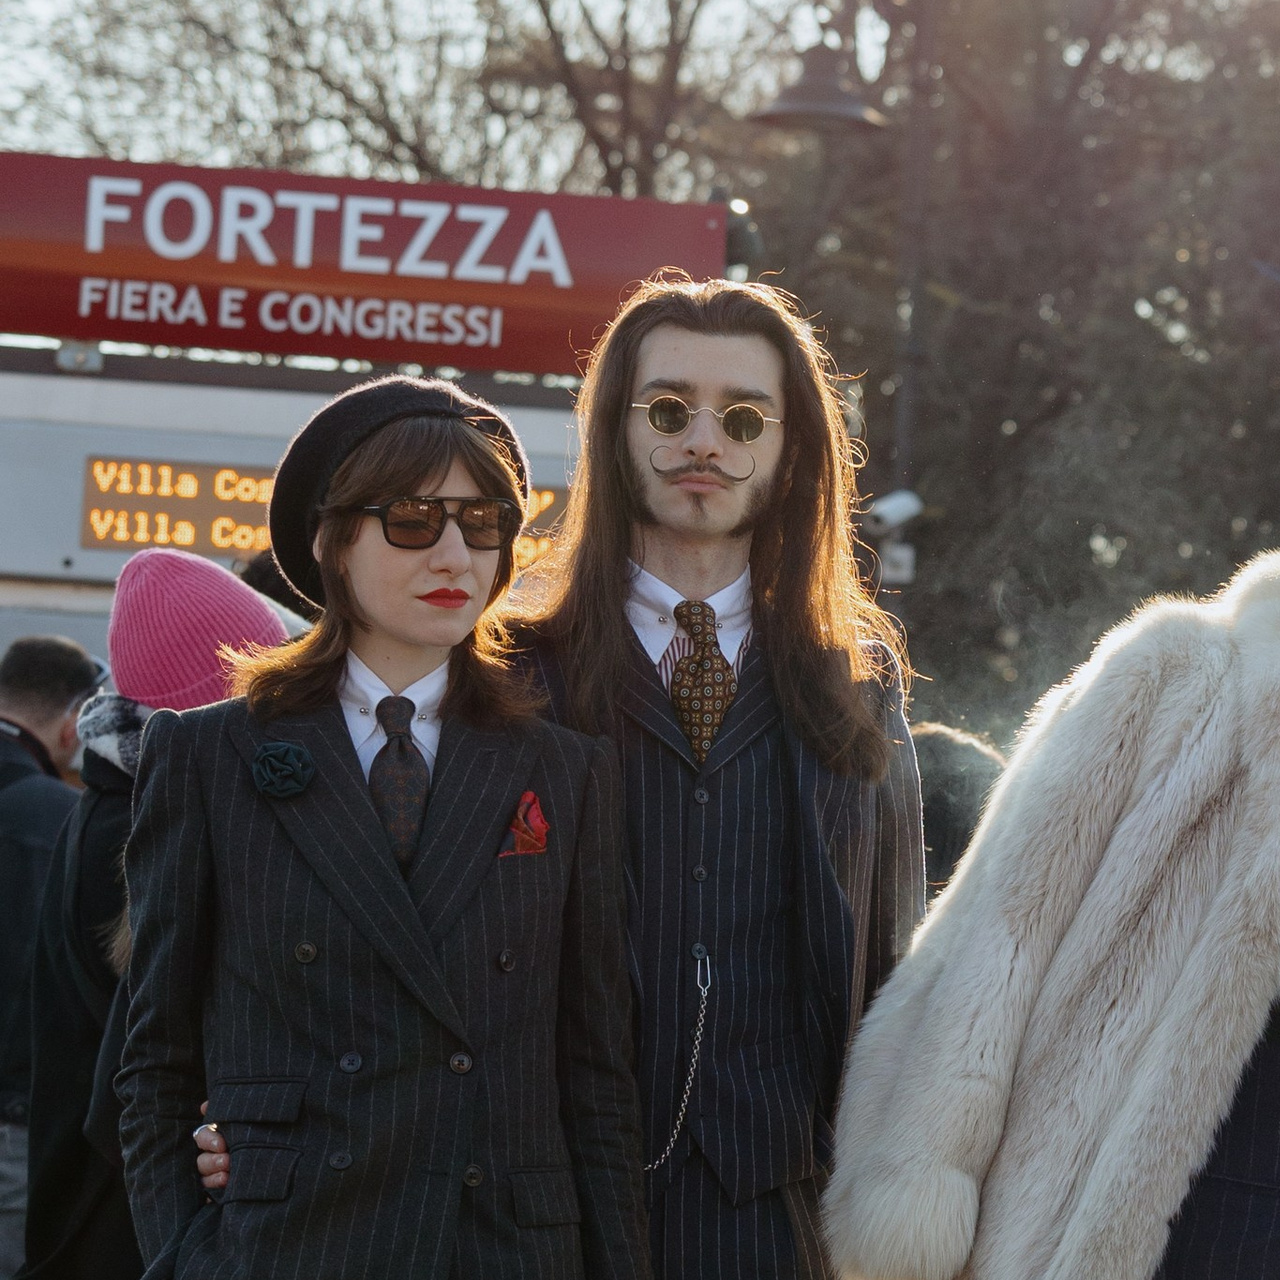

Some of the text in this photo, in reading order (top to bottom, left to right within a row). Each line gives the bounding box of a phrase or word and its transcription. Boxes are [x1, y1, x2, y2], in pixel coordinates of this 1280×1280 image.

[86, 177, 573, 286] FORTEZZA
[80, 278, 504, 348] FIERA E CONGRESSI
[93, 461, 198, 498] Villa
[91, 508, 195, 545] Villa
